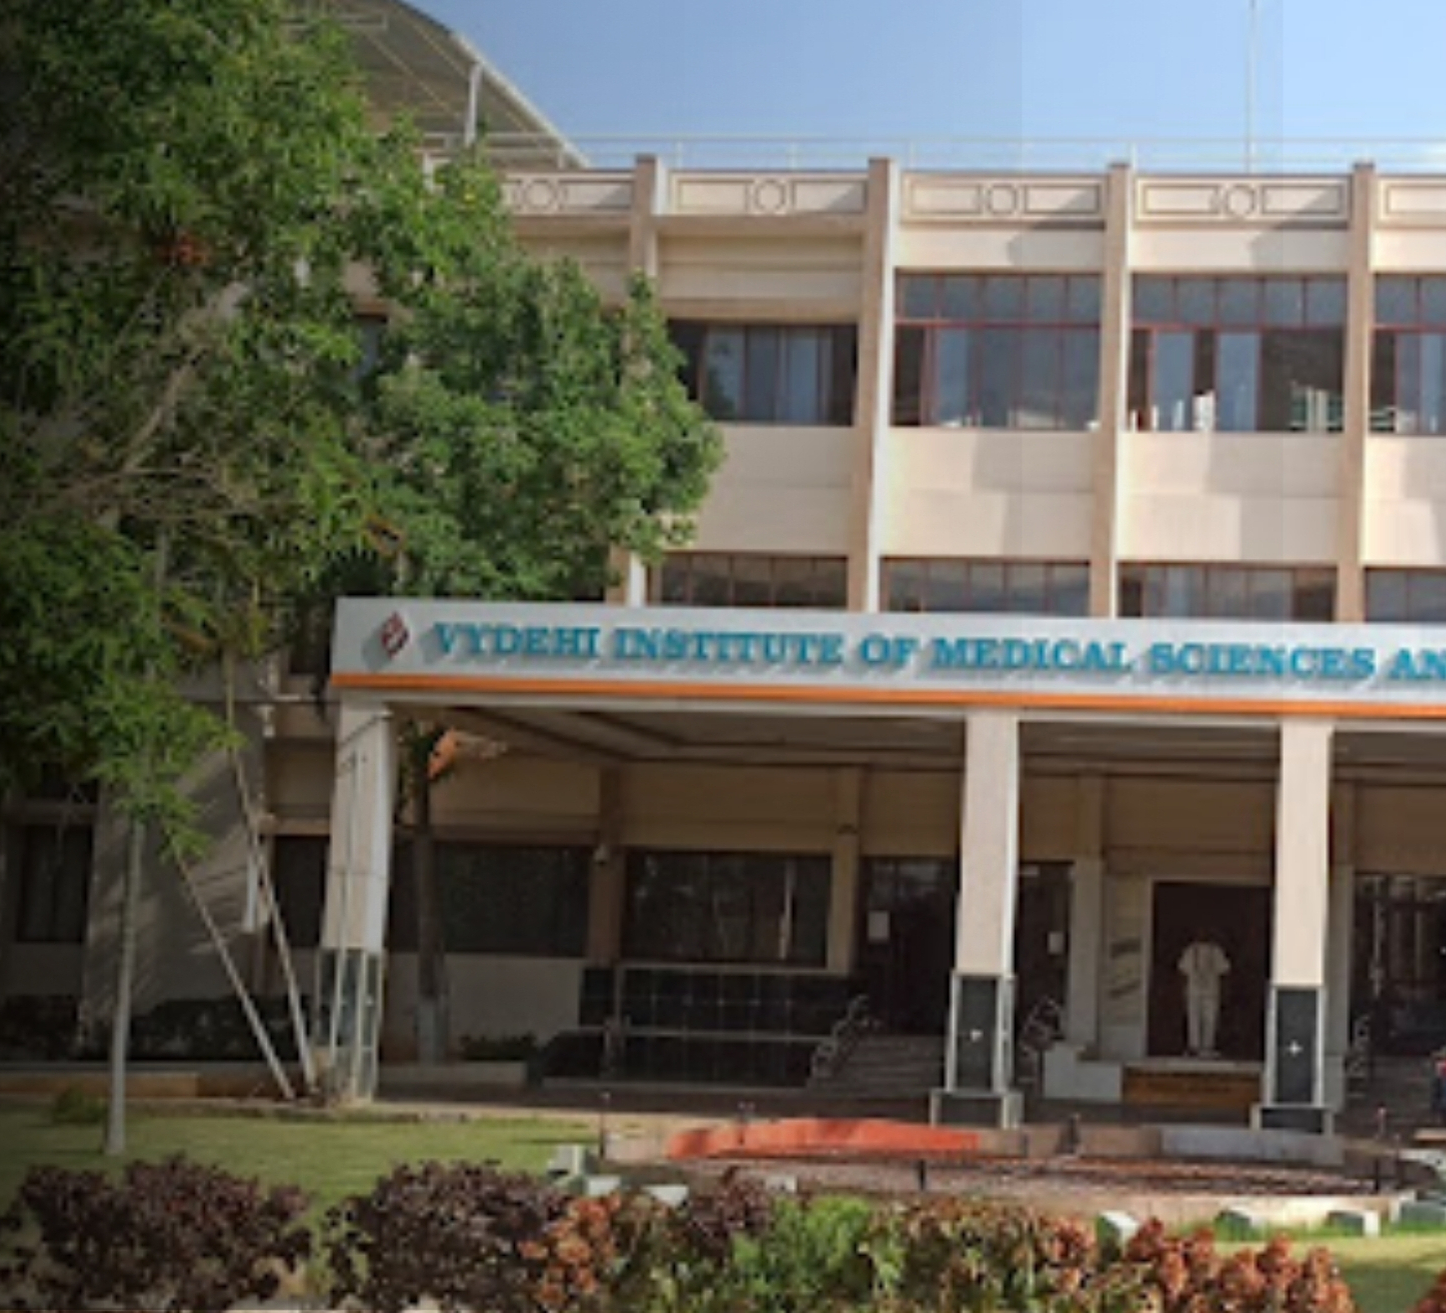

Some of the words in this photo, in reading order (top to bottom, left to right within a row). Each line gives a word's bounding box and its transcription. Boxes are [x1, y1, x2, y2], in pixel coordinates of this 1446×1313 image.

[435, 622, 602, 659] VYDEHI
[613, 626, 846, 666] INSTITUTE
[858, 634, 921, 667] OF
[931, 634, 1131, 673] MEDICAL
[1147, 639, 1377, 681] SCIENCES
